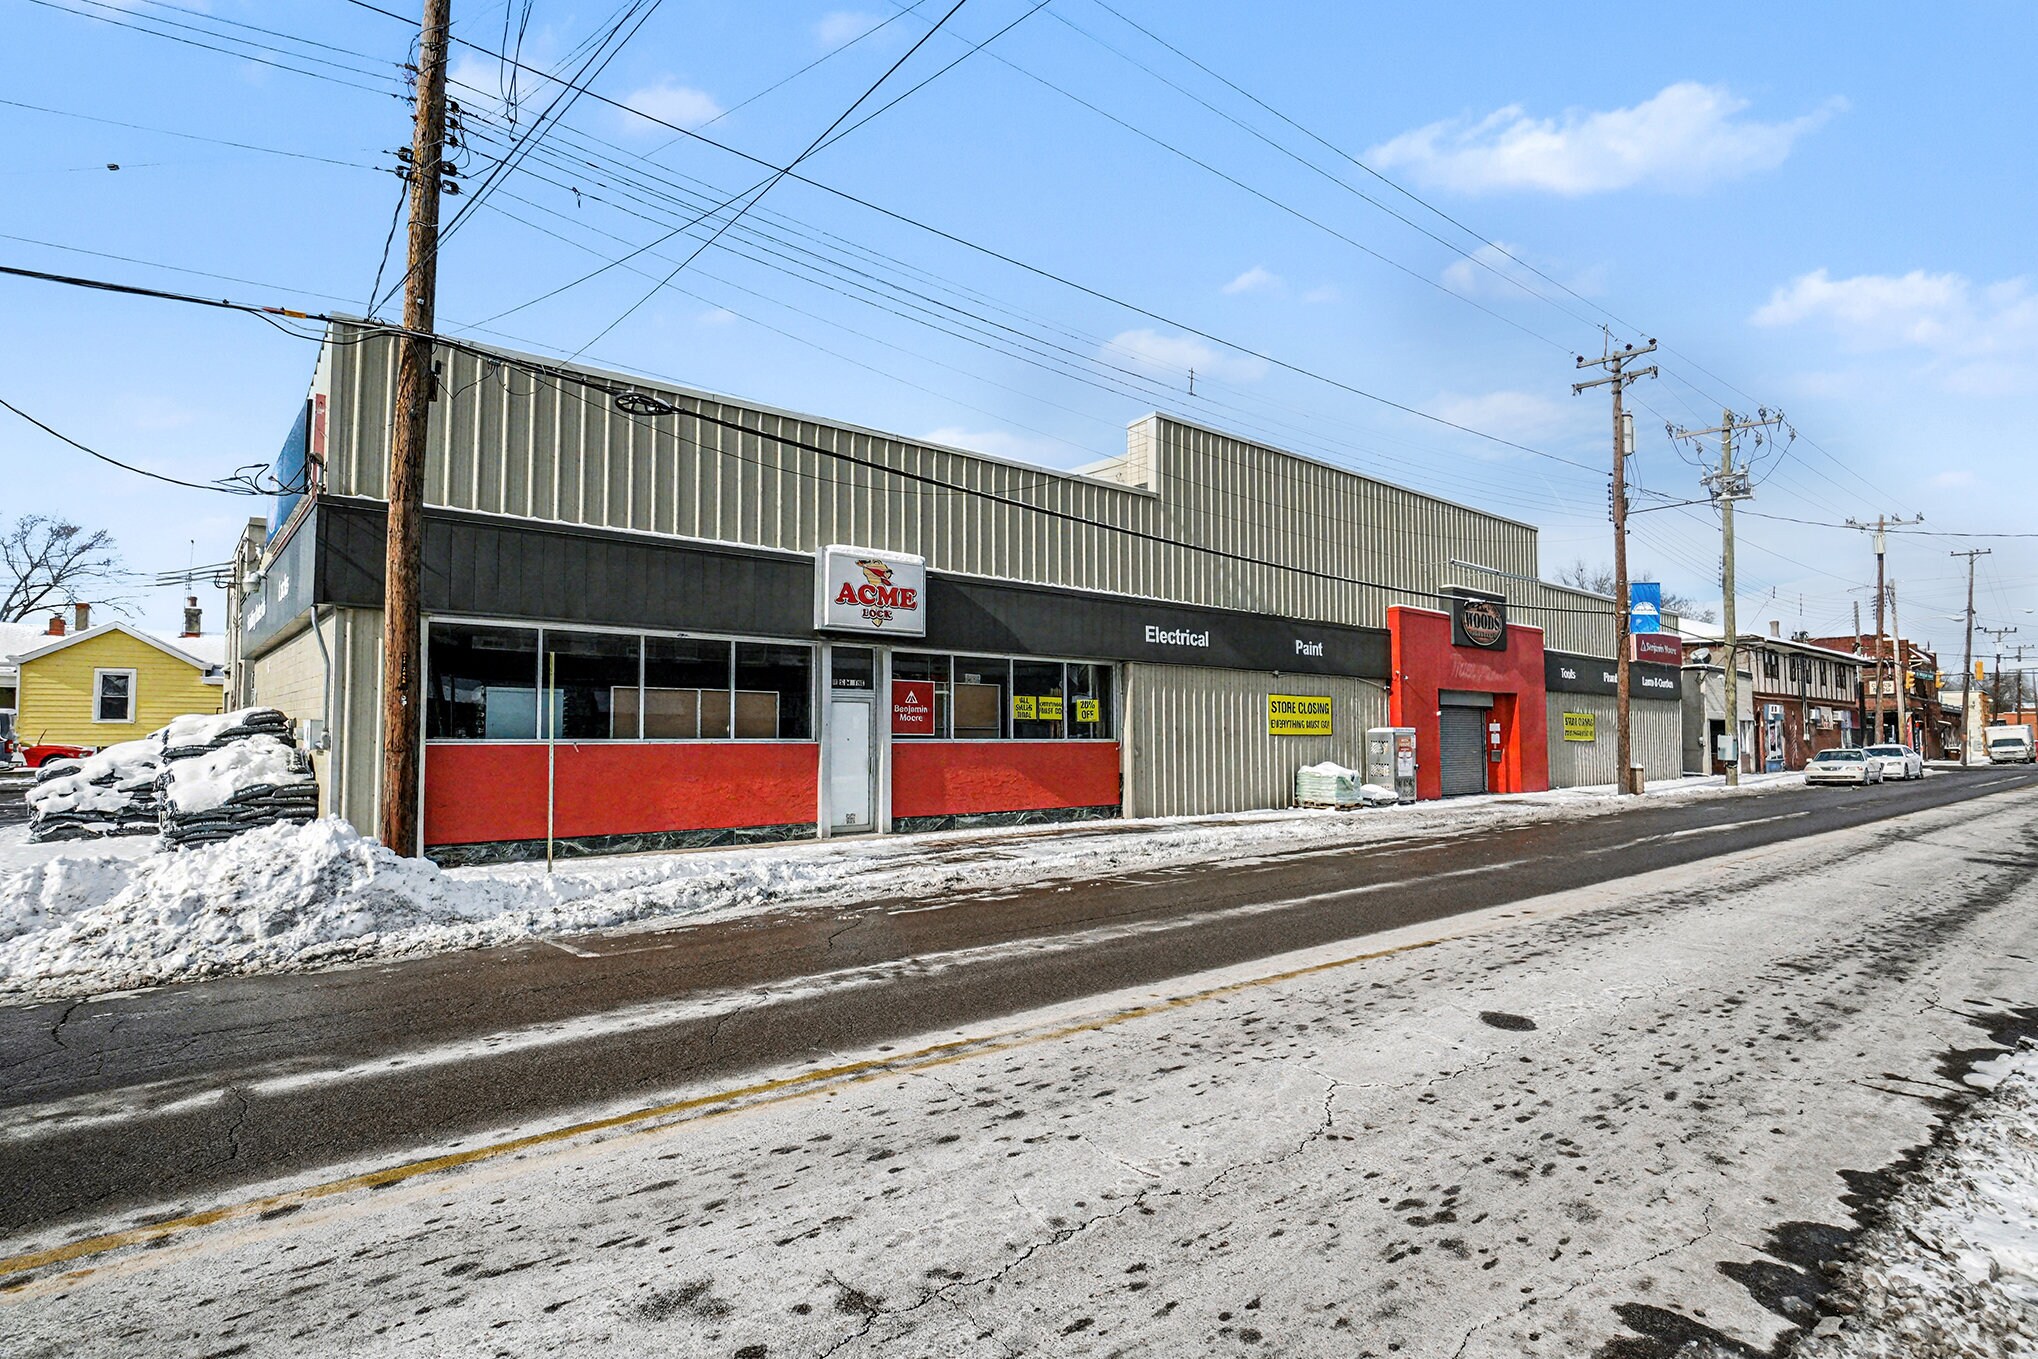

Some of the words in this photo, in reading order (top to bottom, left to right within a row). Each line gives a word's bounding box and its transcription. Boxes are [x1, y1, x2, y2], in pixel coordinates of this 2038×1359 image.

[834, 582, 918, 610] ACME
[862, 608, 893, 621] LOCK
[1464, 611, 1500, 631] WOODS
[1145, 625, 1210, 648] Electrical
[1295, 639, 1323, 657] Paint
[1560, 667, 1577, 680] Tools
[894, 704, 928, 714] Benjamin
[1015, 703, 1033, 712] SALES
[1271, 700, 1296, 714] STORE
[1298, 702, 1330, 715] CLOSING
[899, 713, 923, 722] Moore
[1081, 710, 1095, 719] OFF
[1270, 719, 1305, 729] EVERYTHING
[1306, 720, 1320, 729] MUST
